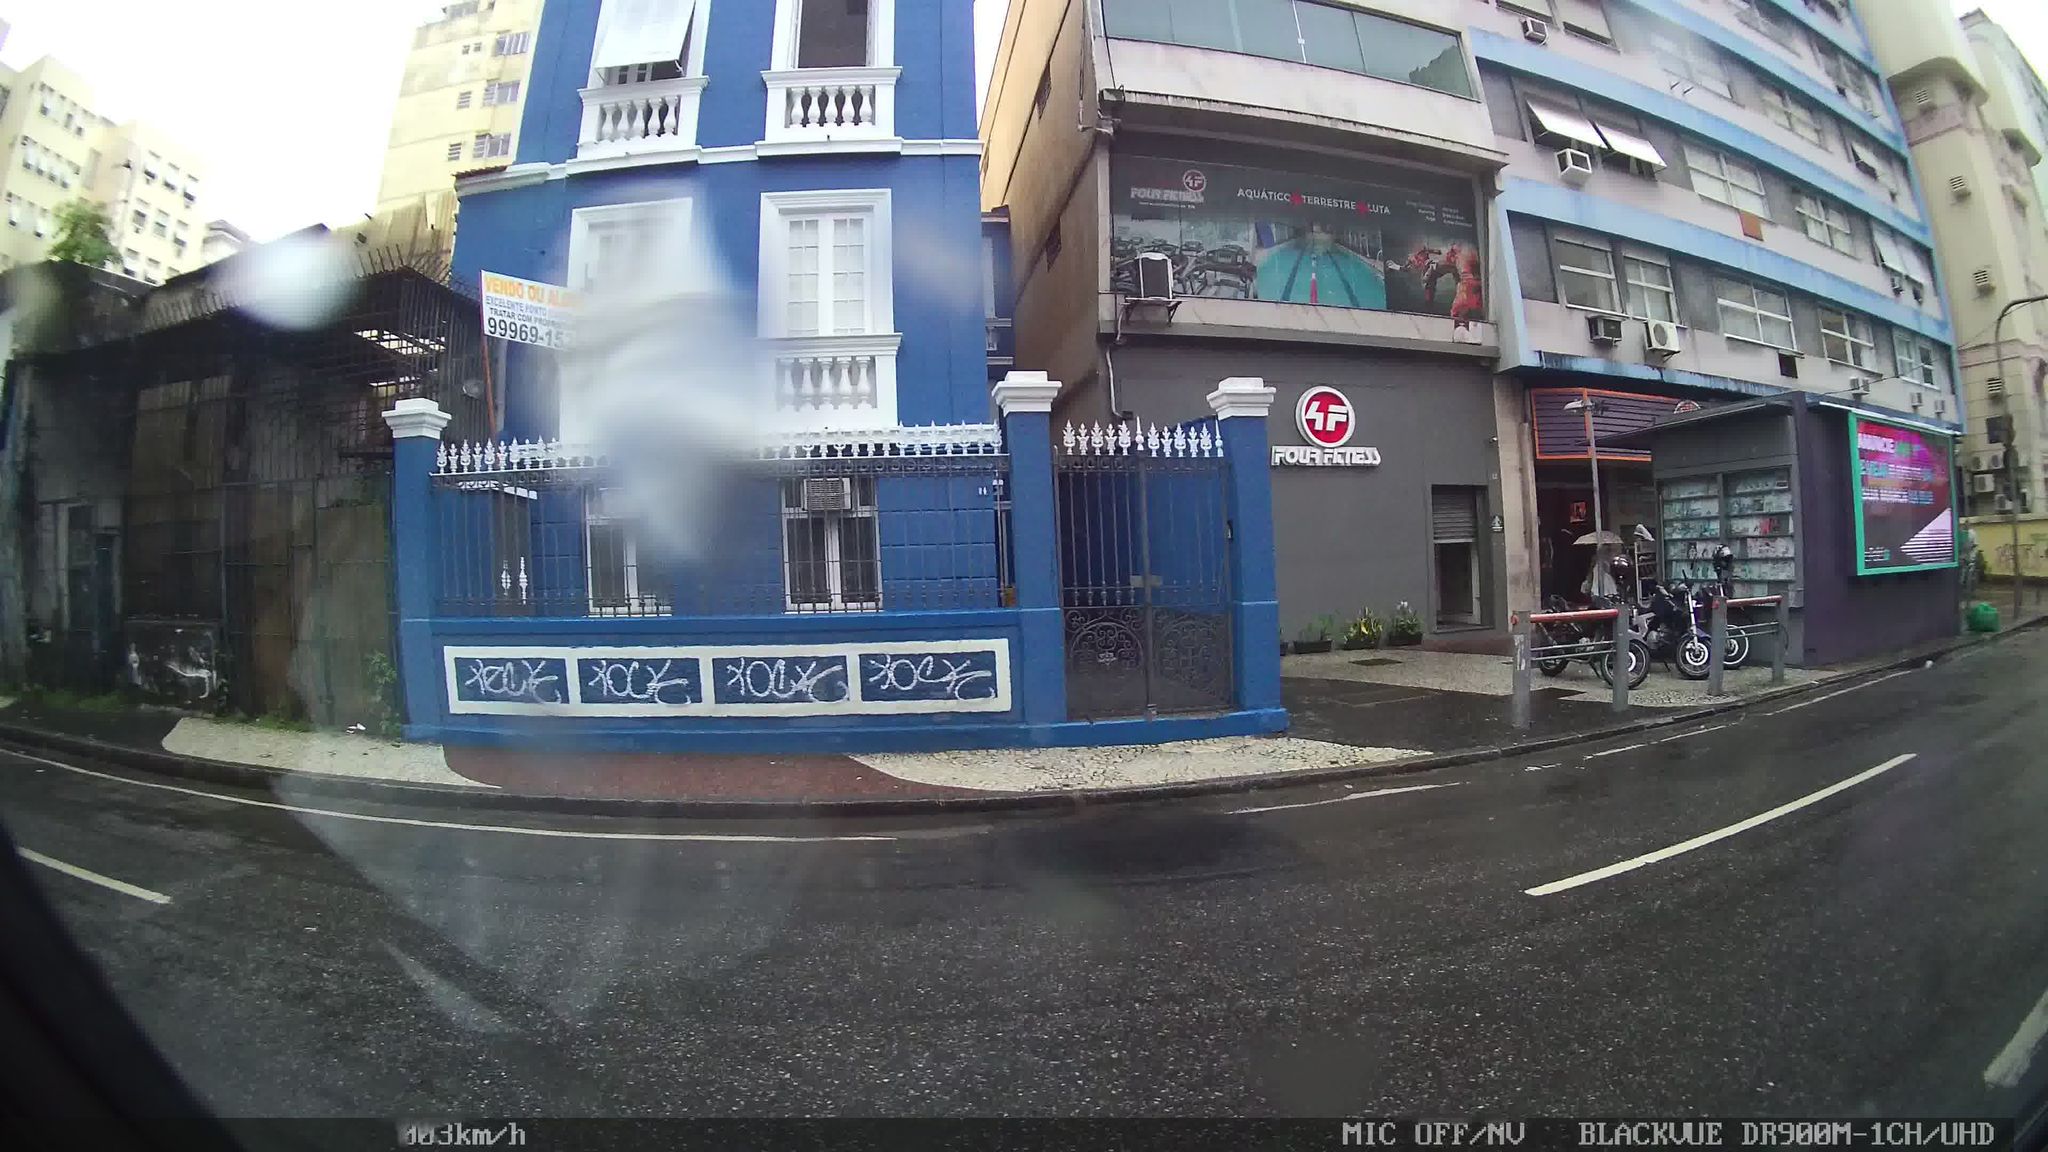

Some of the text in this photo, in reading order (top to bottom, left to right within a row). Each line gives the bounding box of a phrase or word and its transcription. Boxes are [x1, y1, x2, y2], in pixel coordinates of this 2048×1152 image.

[1236, 187, 1291, 203] AQUÁTICO
[1301, 194, 1357, 211] TERRESTRE
[1368, 203, 1392, 216] LUTA
[485, 276, 524, 300] VENDO
[528, 284, 546, 304] OU
[485, 295, 525, 314] EXCELENTE
[489, 307, 516, 321] TRATAR
[517, 313, 533, 324] COM
[487, 316, 572, 348] 99969-15
[1305, 401, 1348, 431] 4F
[1271, 445, 1382, 467] FOUR FITNESS
